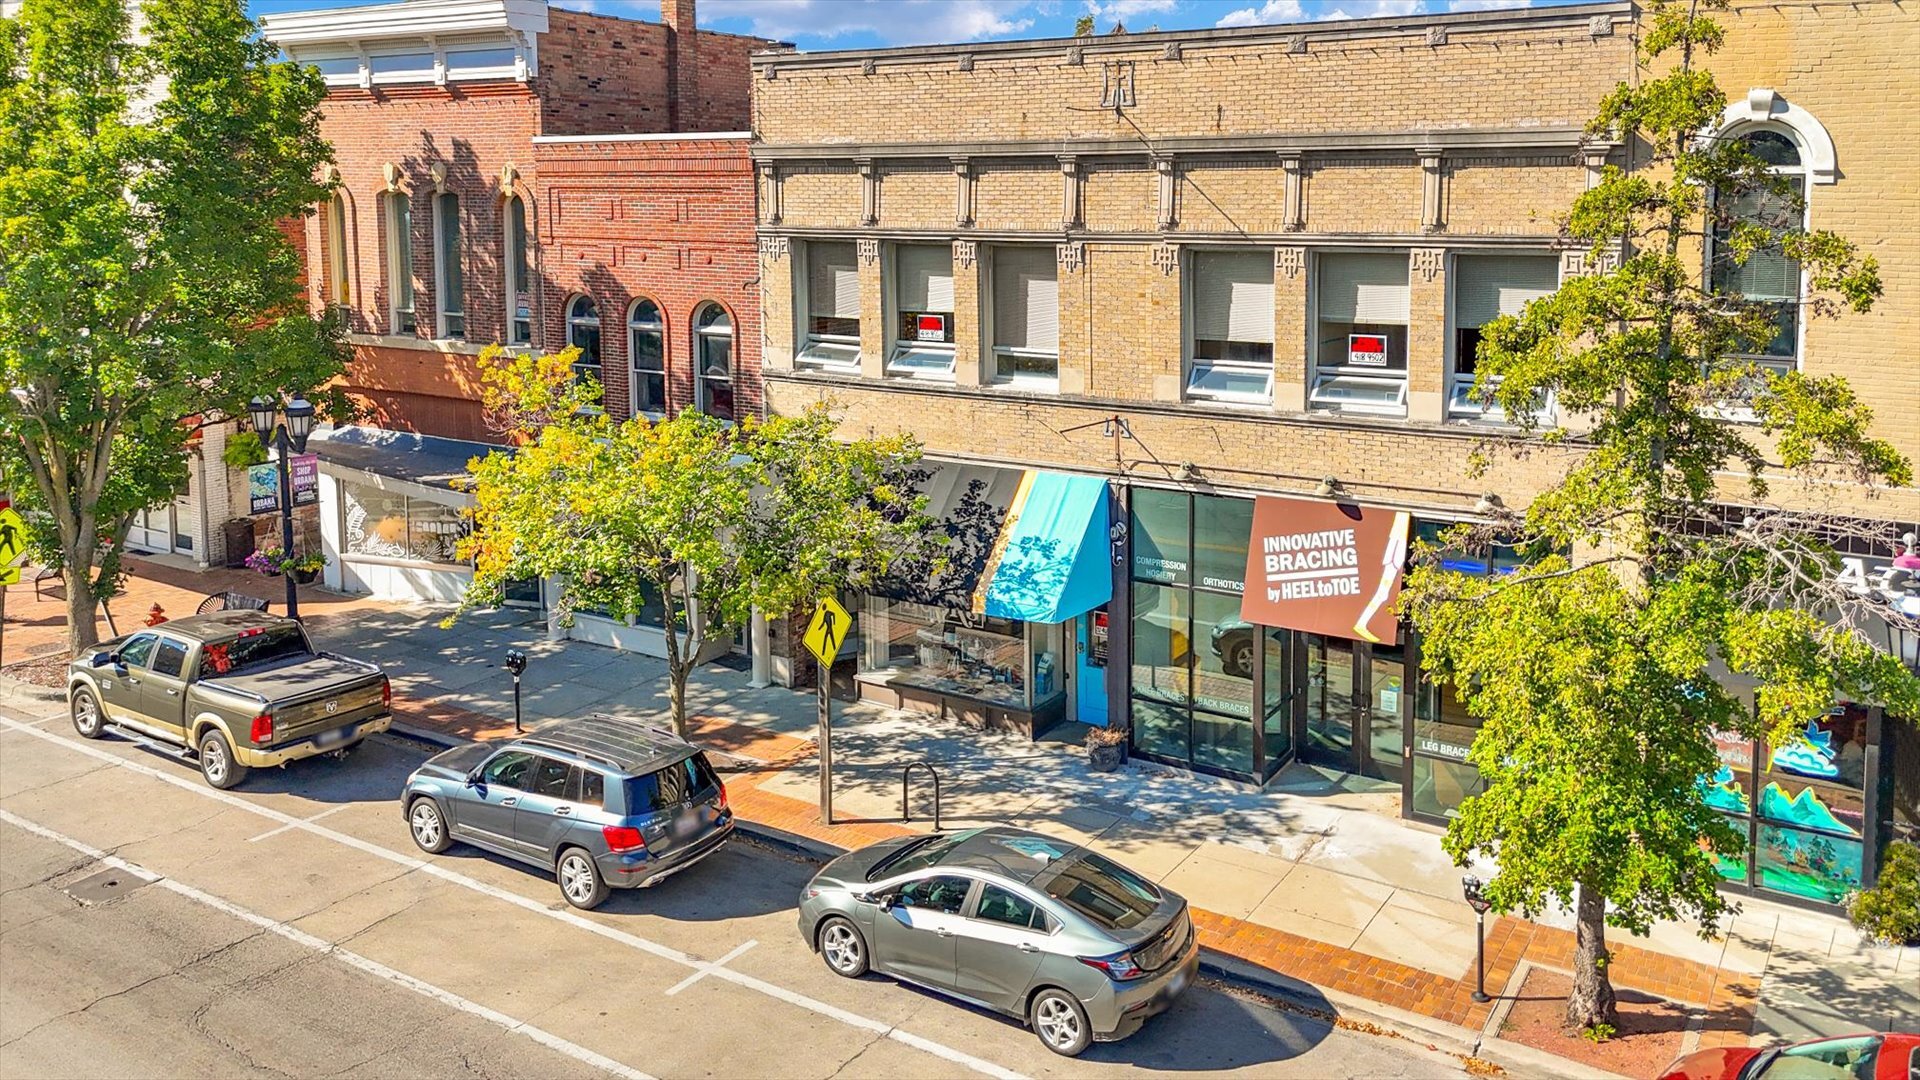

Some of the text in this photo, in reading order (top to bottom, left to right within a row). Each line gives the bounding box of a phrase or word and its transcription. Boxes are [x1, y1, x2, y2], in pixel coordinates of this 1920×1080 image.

[296, 467, 311, 476] SHOP
[294, 475, 316, 485] URBANA
[253, 497, 276, 507] URBANA
[1263, 529, 1356, 553] INNOVATIVE
[1135, 556, 1187, 571] COMPRESSION
[1265, 547, 1358, 573] BRACING
[1145, 568, 1177, 581] HOSIERY
[1203, 577, 1245, 591] ORTHOTICS
[1267, 576, 1361, 604] by HEELtoTOE
[1198, 697, 1250, 714] BACK BRACES
[1422, 740, 1438, 752] LEG
